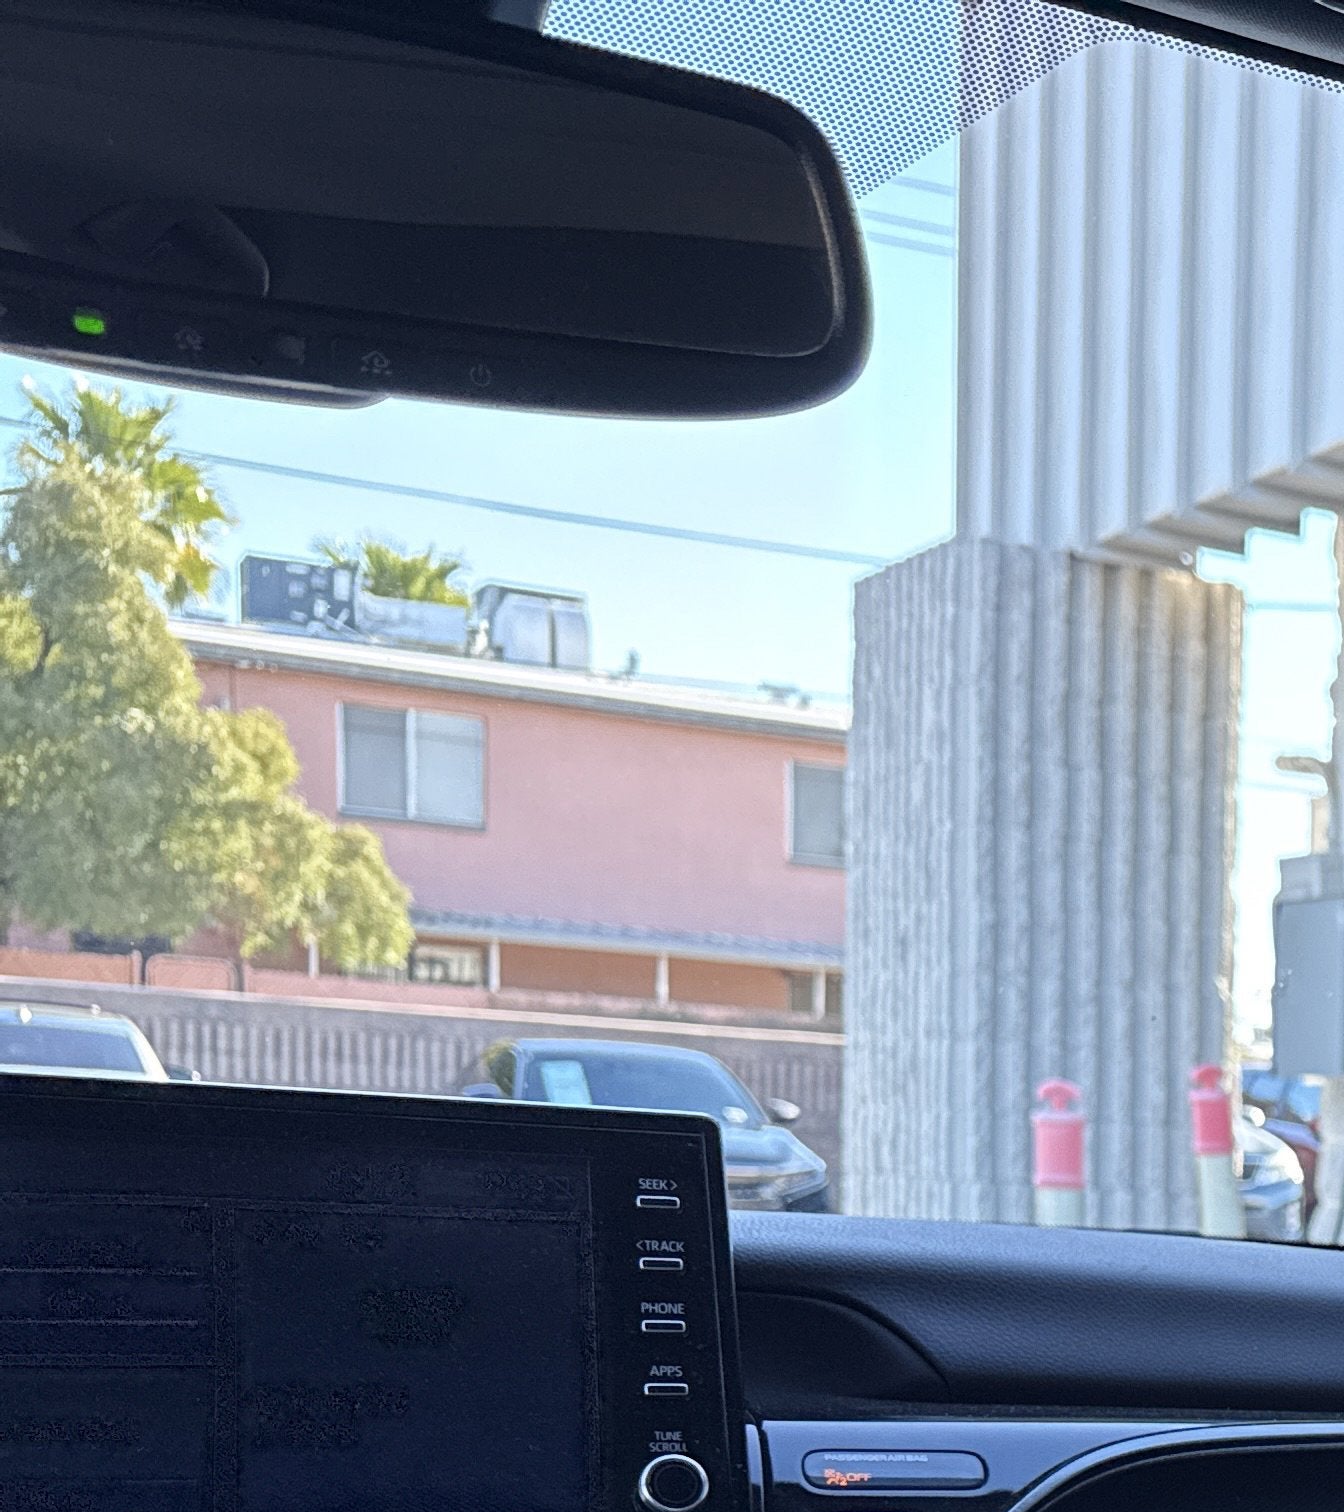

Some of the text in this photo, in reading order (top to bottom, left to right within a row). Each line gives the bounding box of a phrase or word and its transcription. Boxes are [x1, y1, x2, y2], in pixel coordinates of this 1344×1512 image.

[640, 1302, 685, 1314] PHONE
[649, 1365, 683, 1377] APPS
[654, 1431, 683, 1441] TUNE
[649, 1442, 688, 1453] SCROLL
[846, 1472, 872, 1482] OFF
